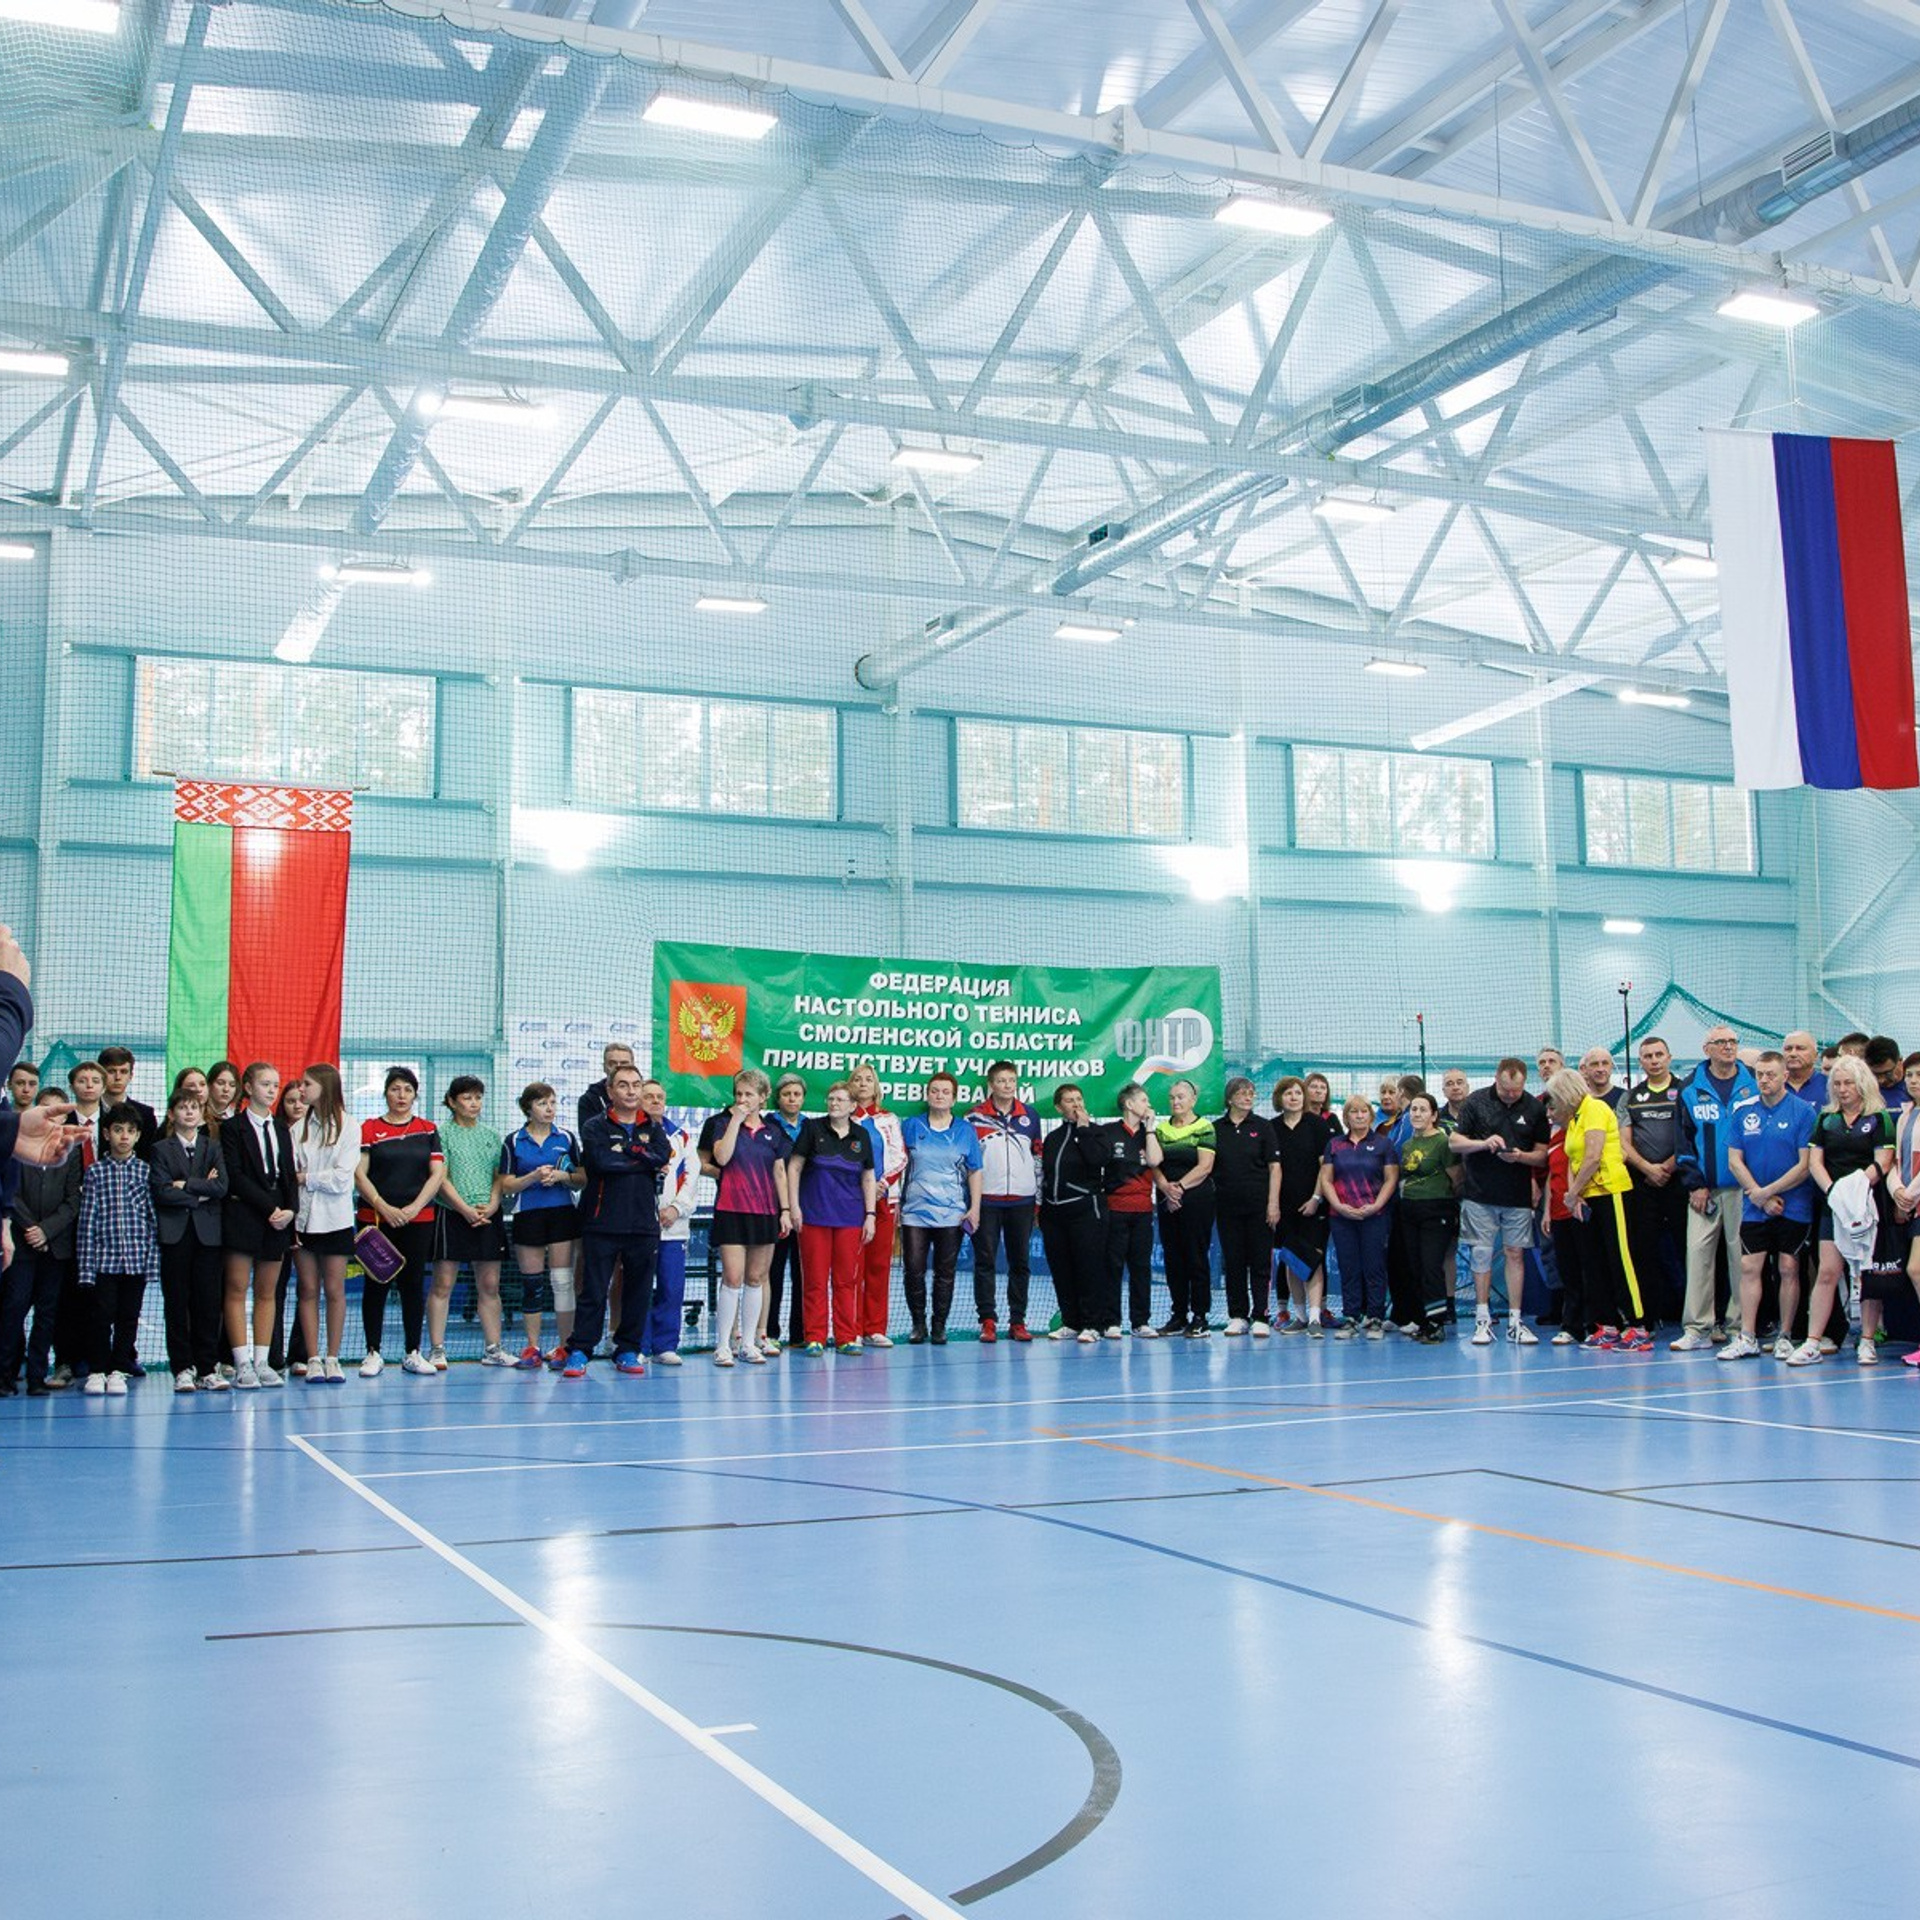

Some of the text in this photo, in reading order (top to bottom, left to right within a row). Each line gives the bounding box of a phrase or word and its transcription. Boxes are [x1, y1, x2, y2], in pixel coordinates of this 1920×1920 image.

[869, 972, 1011, 999] ФЕДЕРАЦИЯ
[794, 995, 1082, 1025] НАСТОЛЬНОГО ТЕННИСА
[799, 1023, 1074, 1051] СМОЛЕНСКОЙ ОБЛАСТИ
[954, 1057, 1105, 1077] УЧТНИКОВ
[1693, 1103, 1720, 1121] RUS
